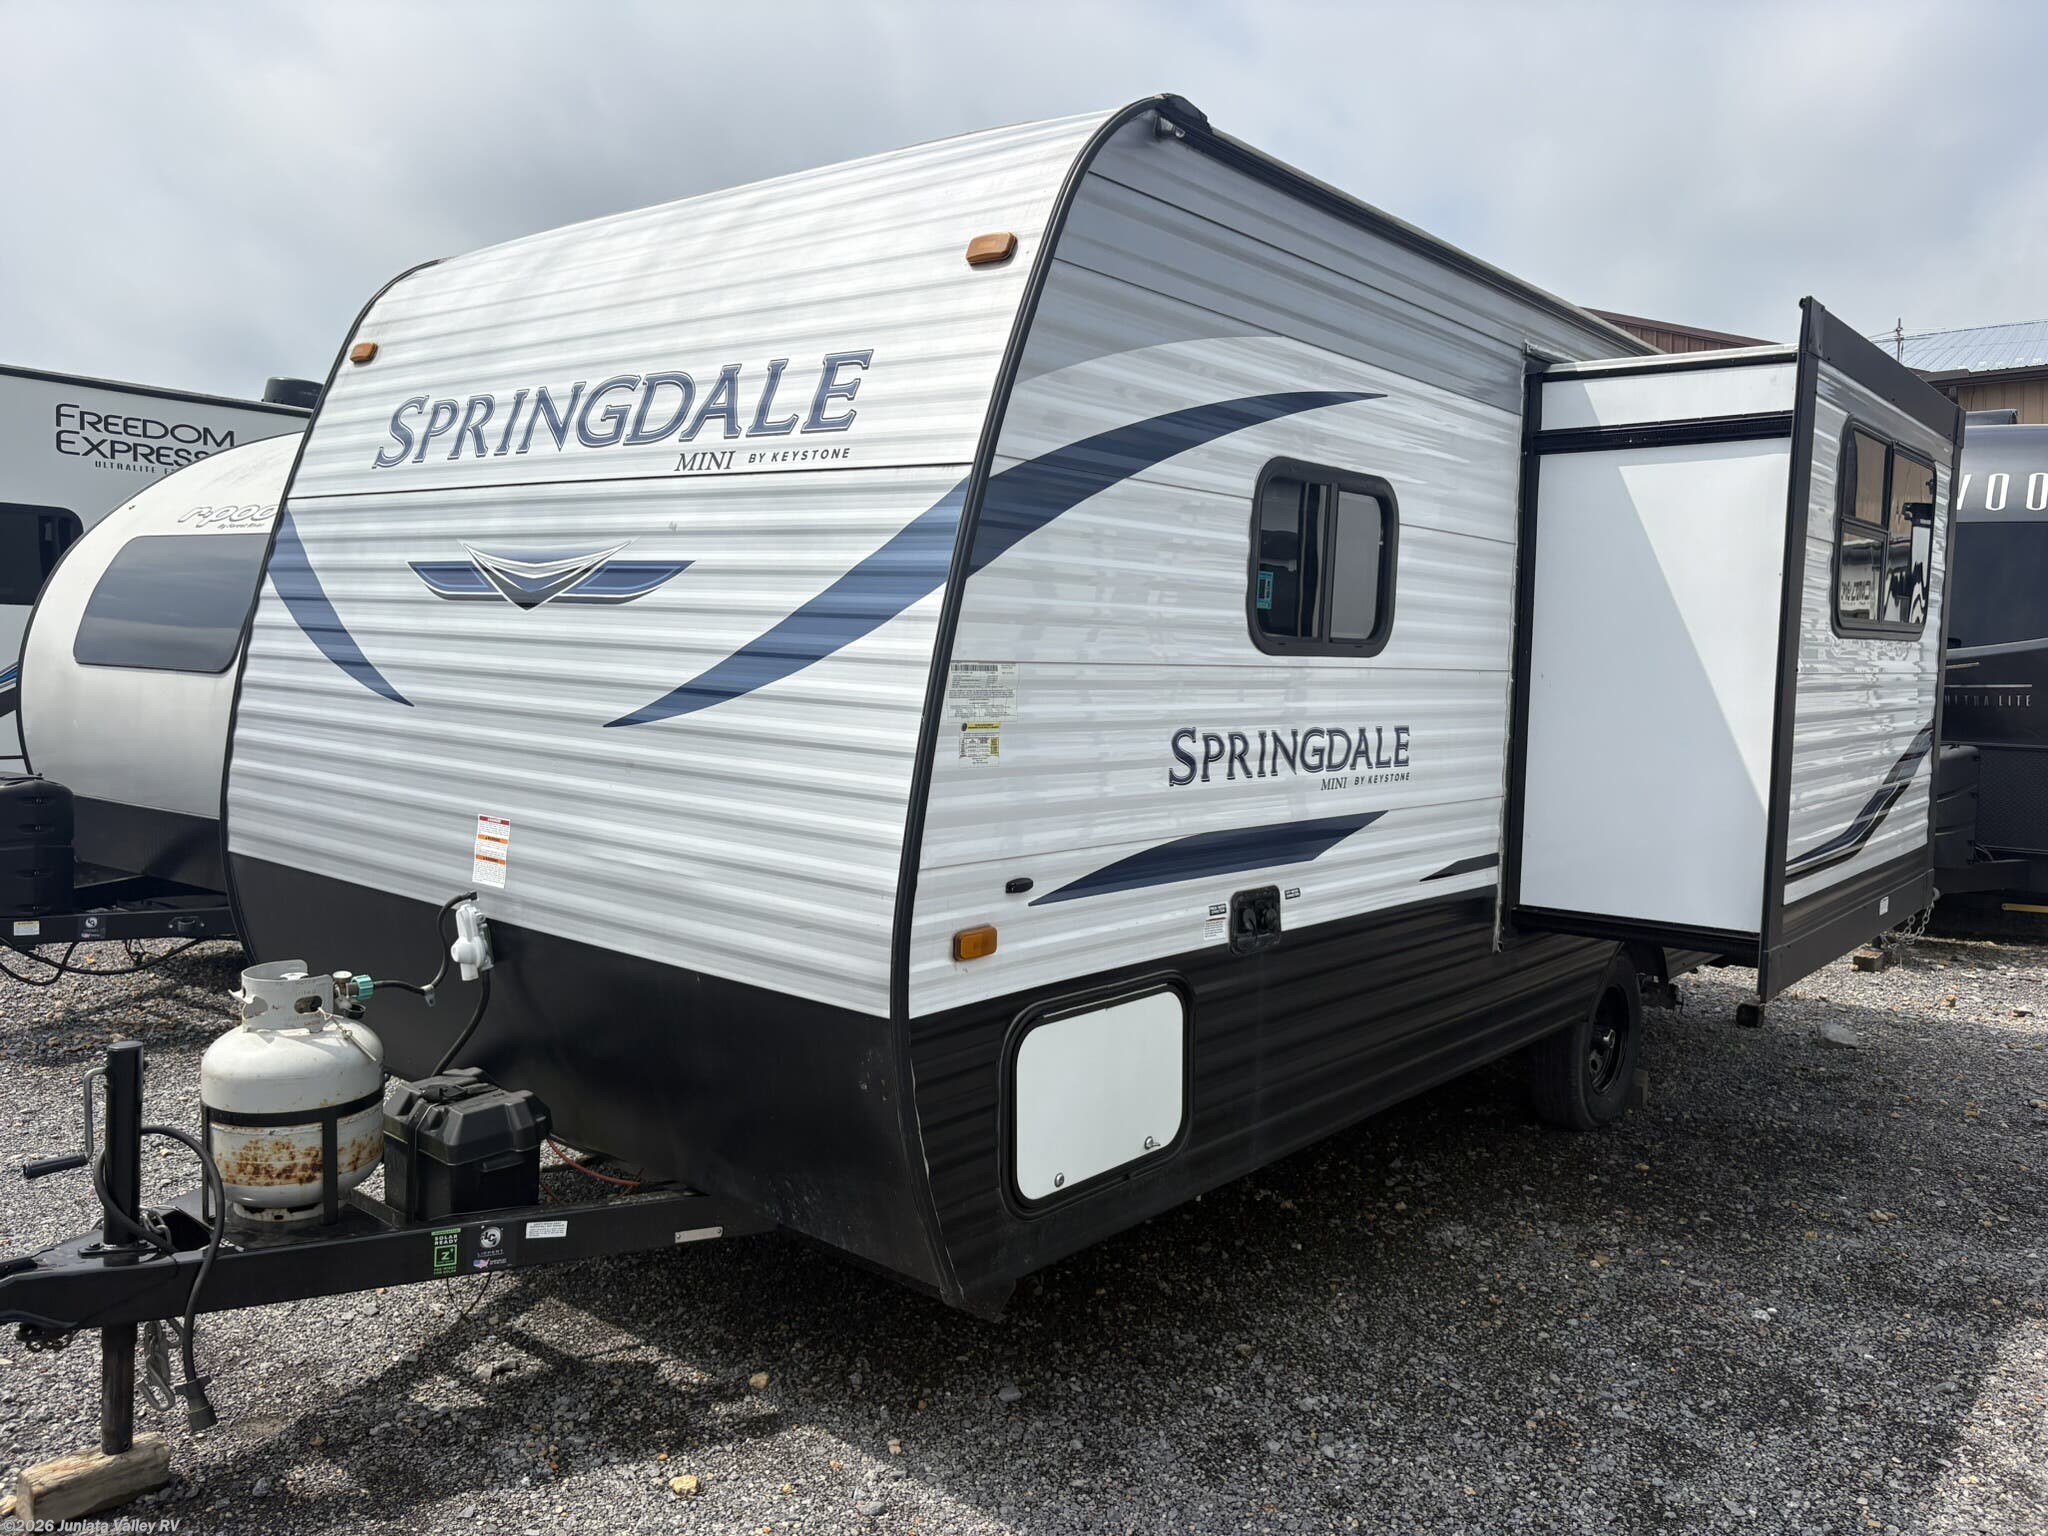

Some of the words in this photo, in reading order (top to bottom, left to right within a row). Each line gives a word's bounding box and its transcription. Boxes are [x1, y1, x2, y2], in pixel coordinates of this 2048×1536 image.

[371, 348, 874, 469] SPRINGDALE
[55, 403, 235, 448] FREEDOM
[95, 460, 156, 474] ULTRALITE
[674, 450, 736, 472] MINI
[748, 453, 766, 464] BY
[771, 448, 850, 463] KEYSTONE
[1999, 695, 2031, 707] LITE
[1168, 725, 1410, 787] SPRINGDALE
[1320, 777, 1347, 791] MINI
[1354, 776, 1365, 785] BY
[1367, 772, 1410, 784] KEYSTONE
